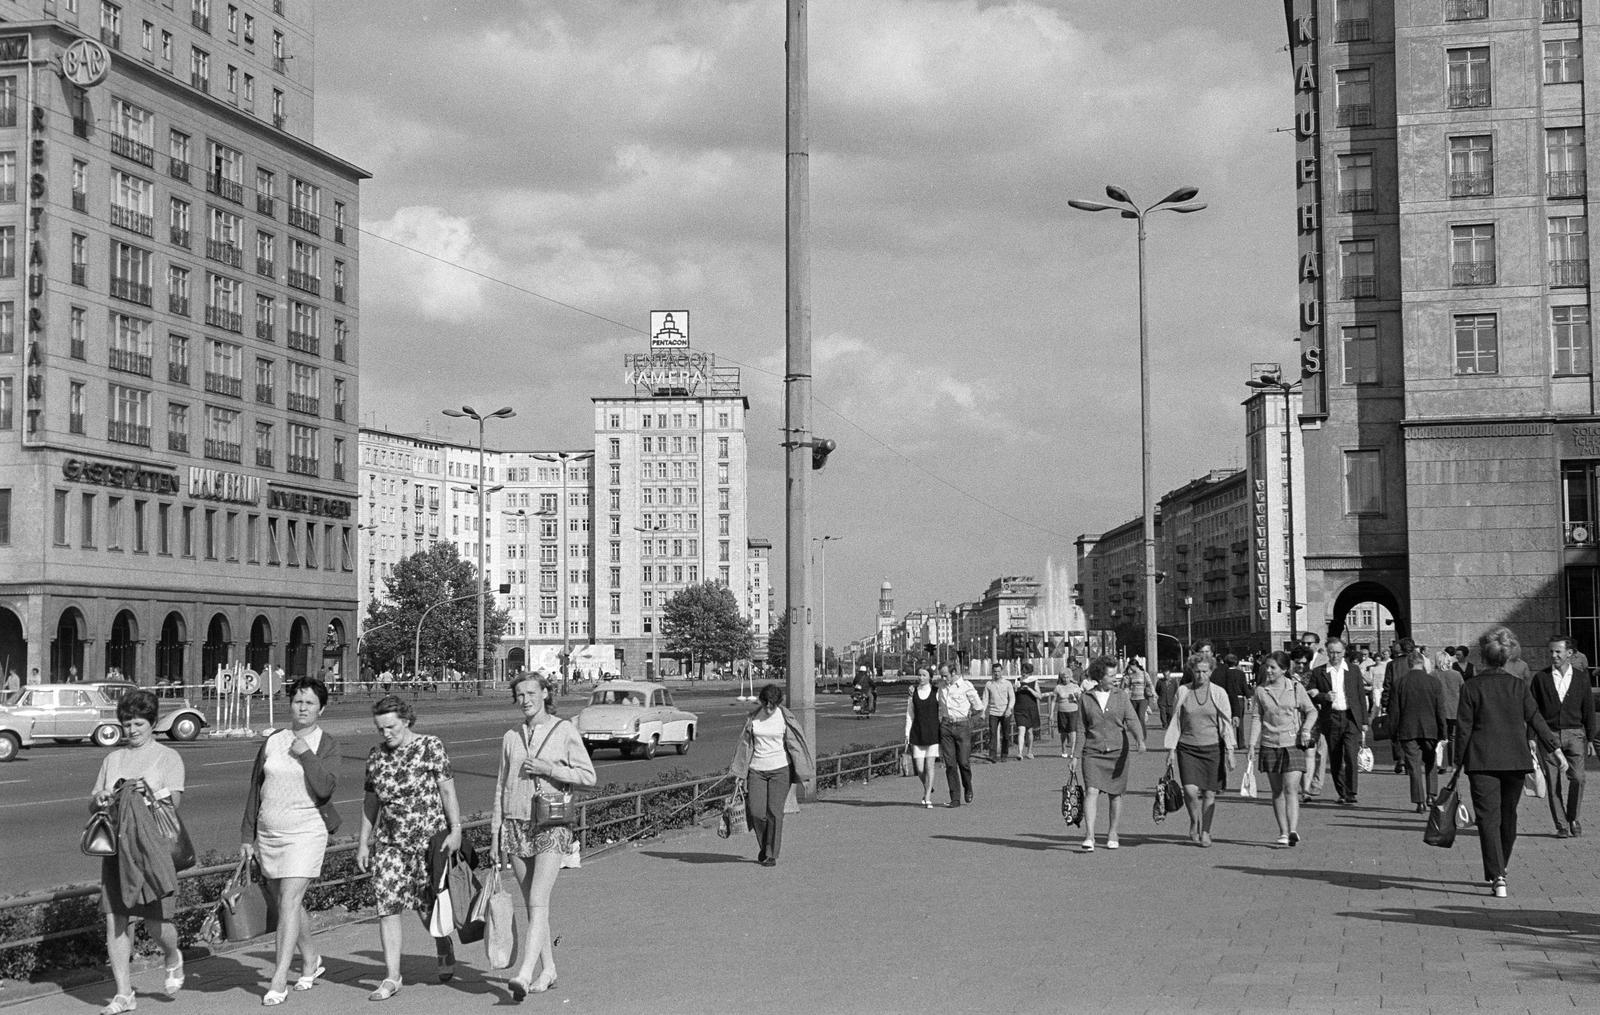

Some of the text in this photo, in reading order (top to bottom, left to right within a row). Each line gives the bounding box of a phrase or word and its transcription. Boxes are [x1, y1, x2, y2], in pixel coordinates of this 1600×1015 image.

[68, 41, 102, 81] BAR
[1298, 14, 1321, 373] KAUFHAUS
[28, 106, 45, 434] RESTAURANT
[624, 353, 715, 367] PENTACON
[624, 371, 704, 385] KAMERA
[62, 458, 180, 494] GASTSTÄTTEN
[188, 466, 223, 500] HAUS
[223, 674, 232, 690] P
[245, 675, 254, 690] P
